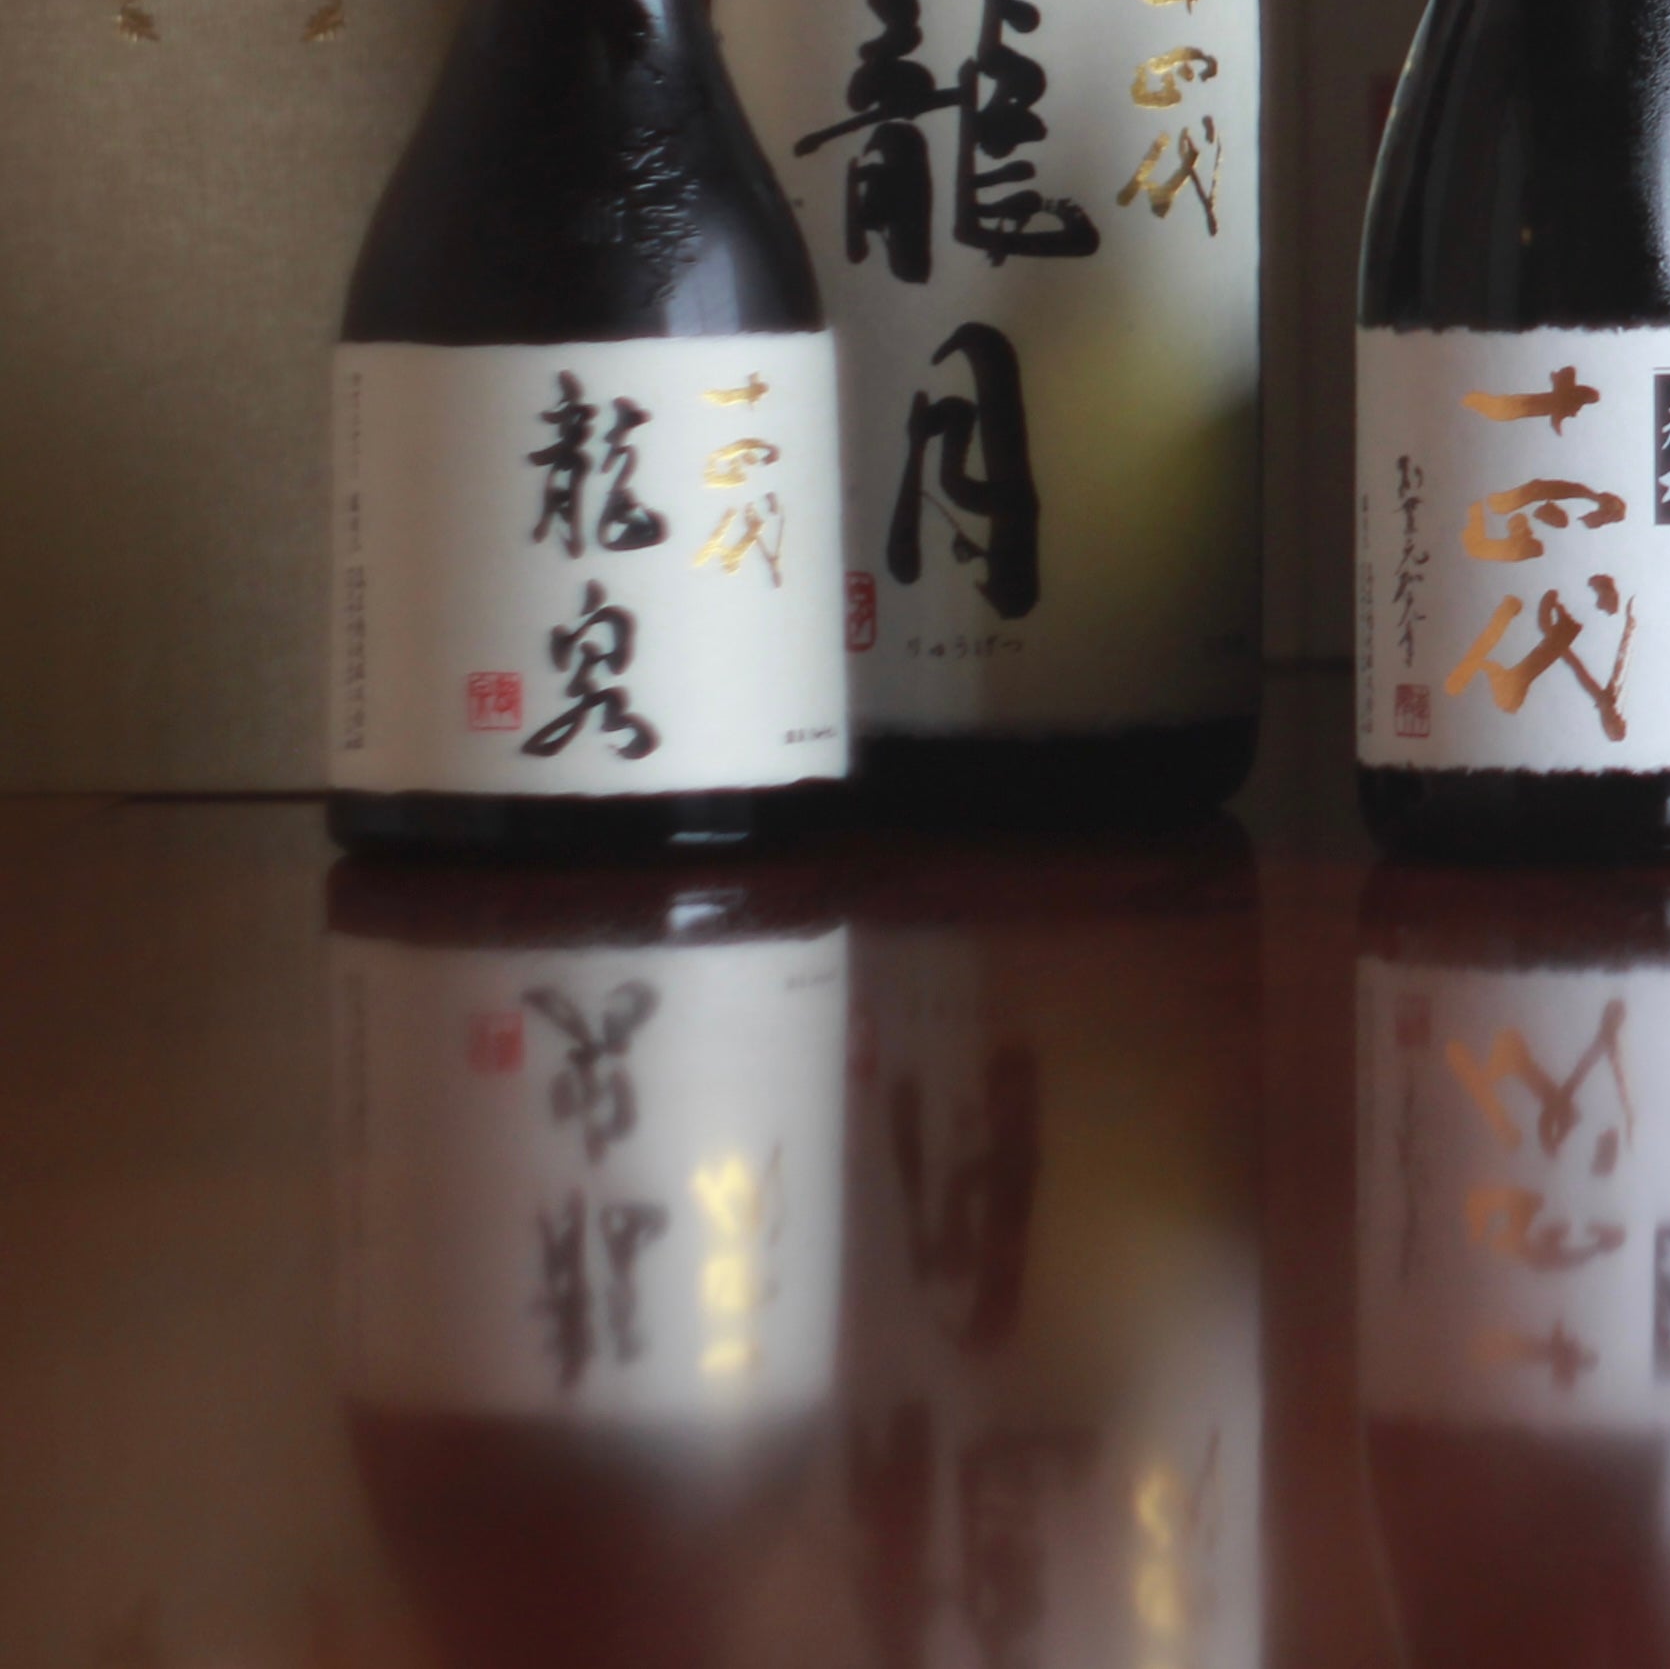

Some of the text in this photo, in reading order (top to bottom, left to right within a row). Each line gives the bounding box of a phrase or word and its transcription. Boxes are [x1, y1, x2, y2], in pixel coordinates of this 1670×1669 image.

[693, 372, 785, 588] 十四代
[1445, 366, 1635, 742] 十四代
